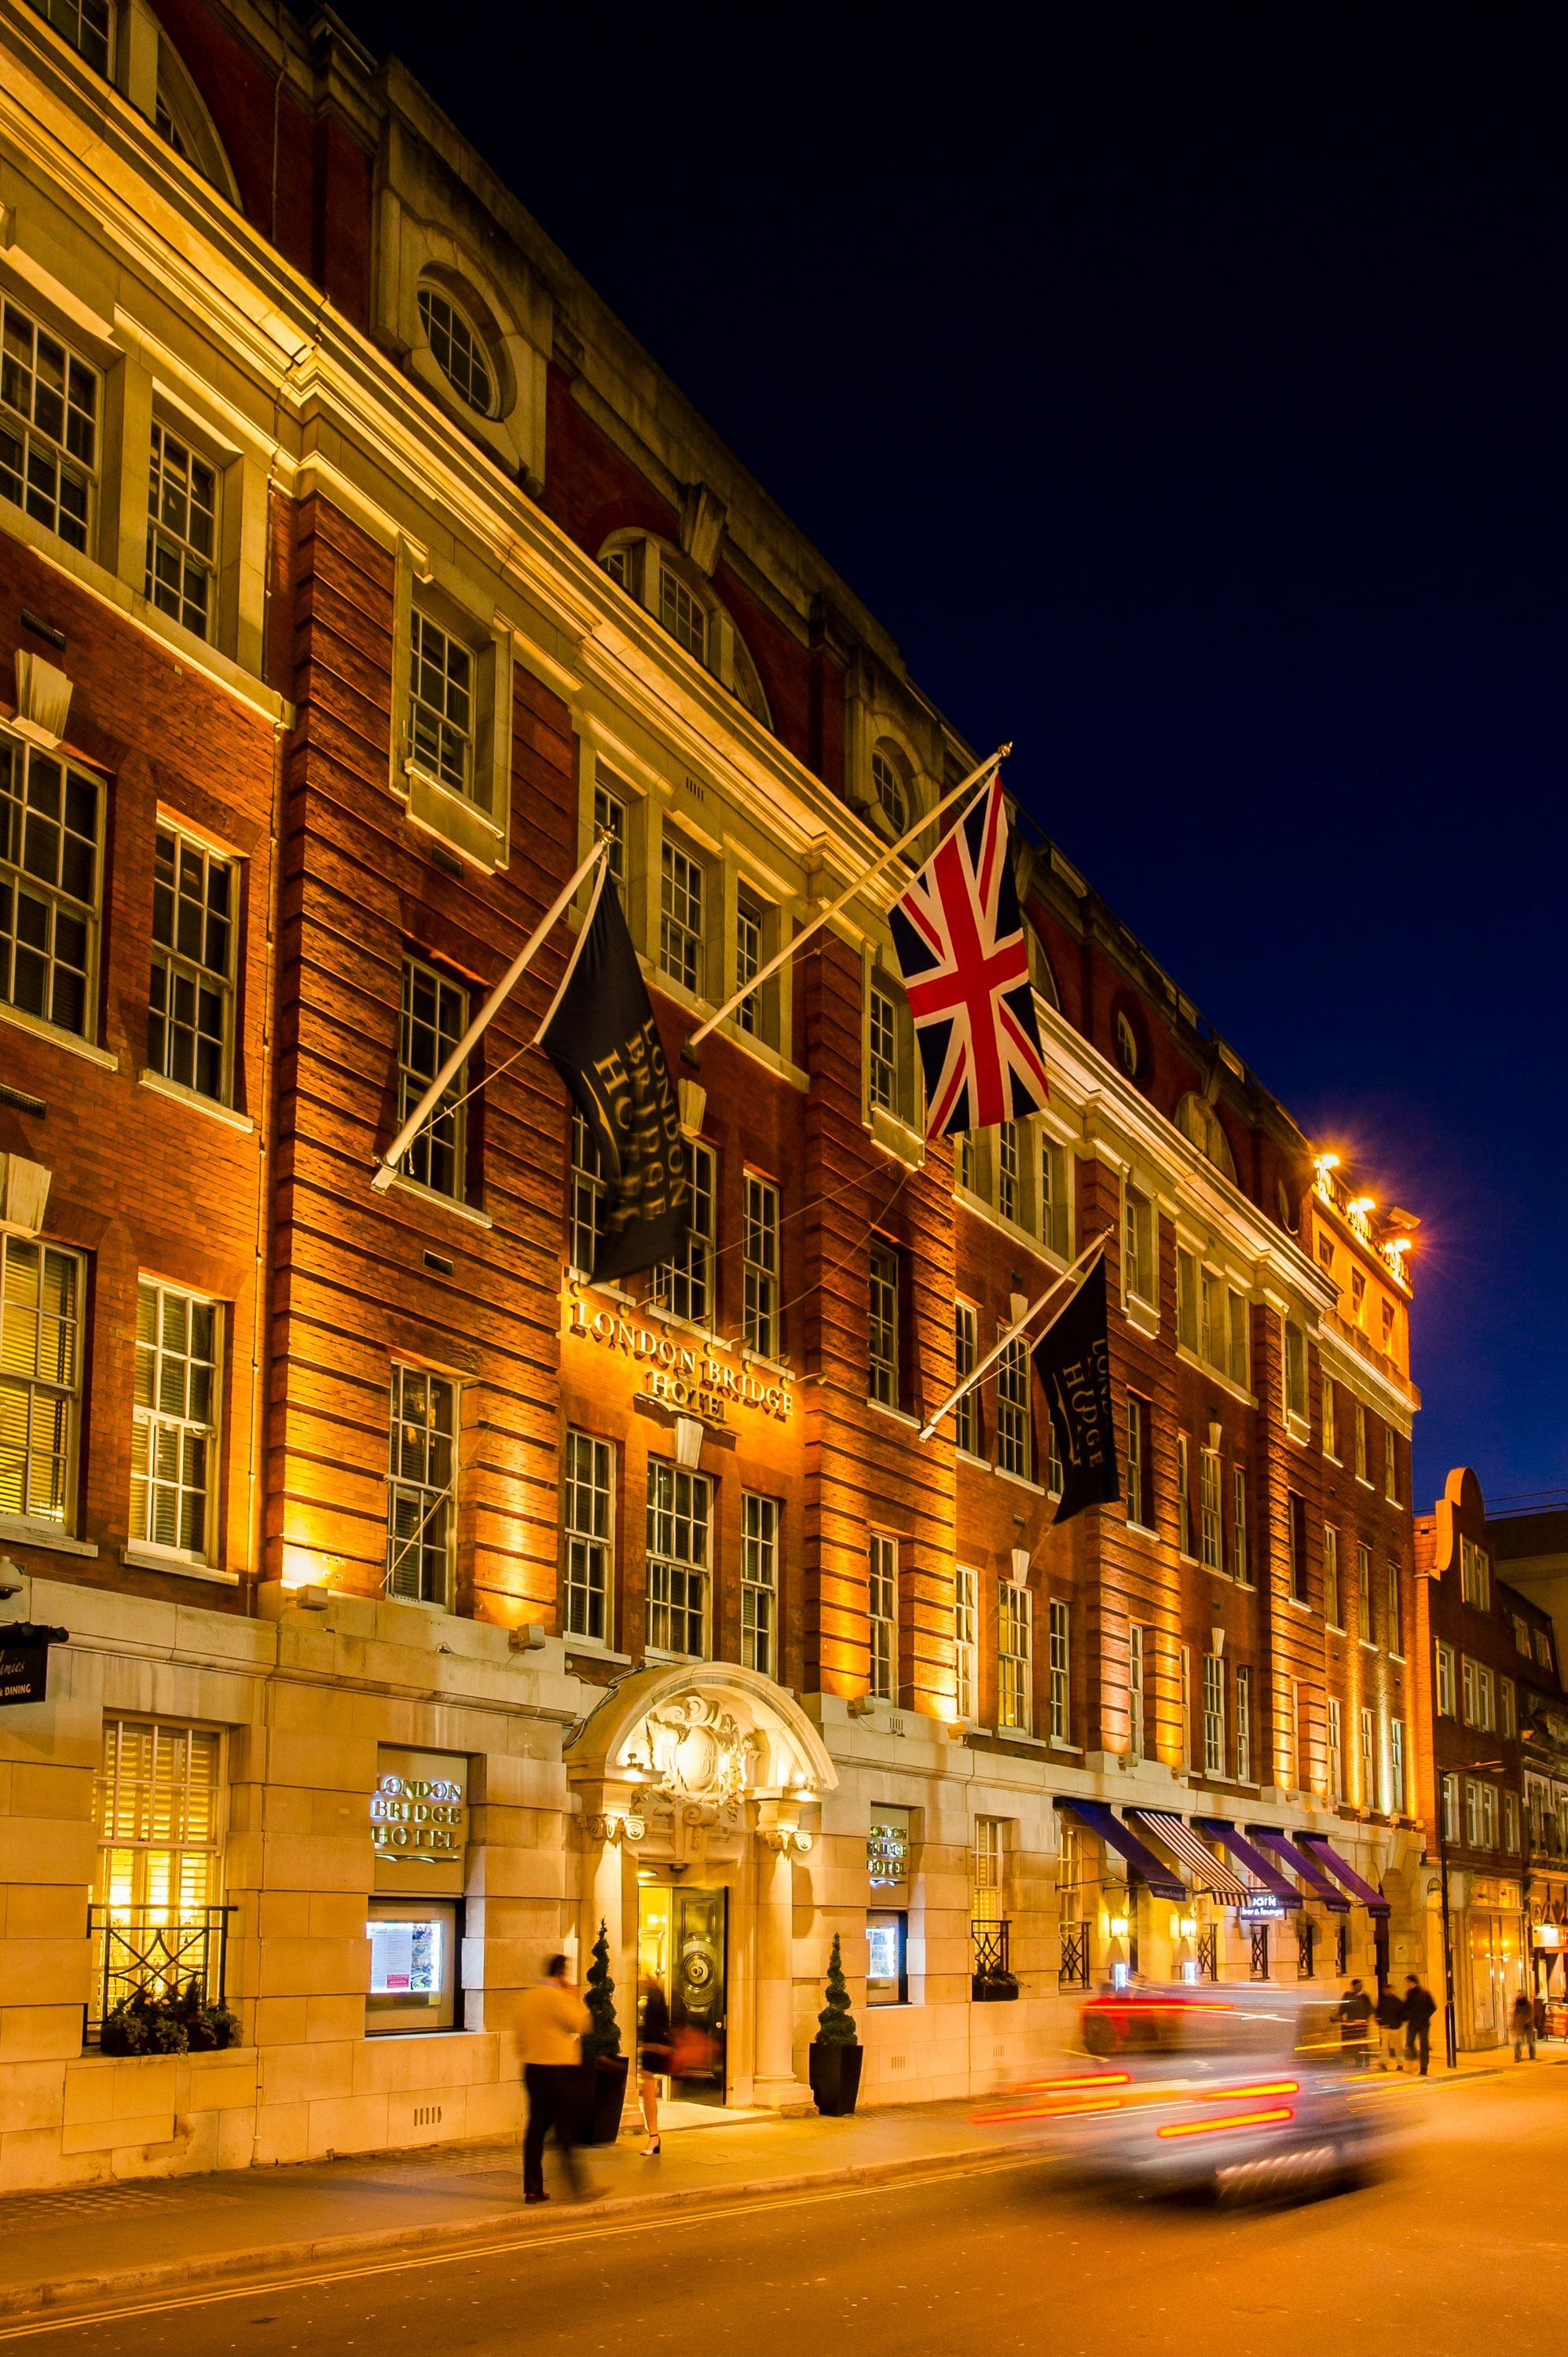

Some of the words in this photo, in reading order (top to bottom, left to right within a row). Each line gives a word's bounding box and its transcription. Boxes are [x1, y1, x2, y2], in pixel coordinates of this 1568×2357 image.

[576, 1300, 696, 1373] LONDON
[708, 1359, 794, 1417] BRIDGE
[650, 1370, 726, 1421] HOTEL
[5, 1683, 31, 1696] DINING
[376, 1776, 463, 1801] LONDON
[372, 1800, 462, 1824] BRIDGE
[371, 1826, 460, 1849] HOTEL
